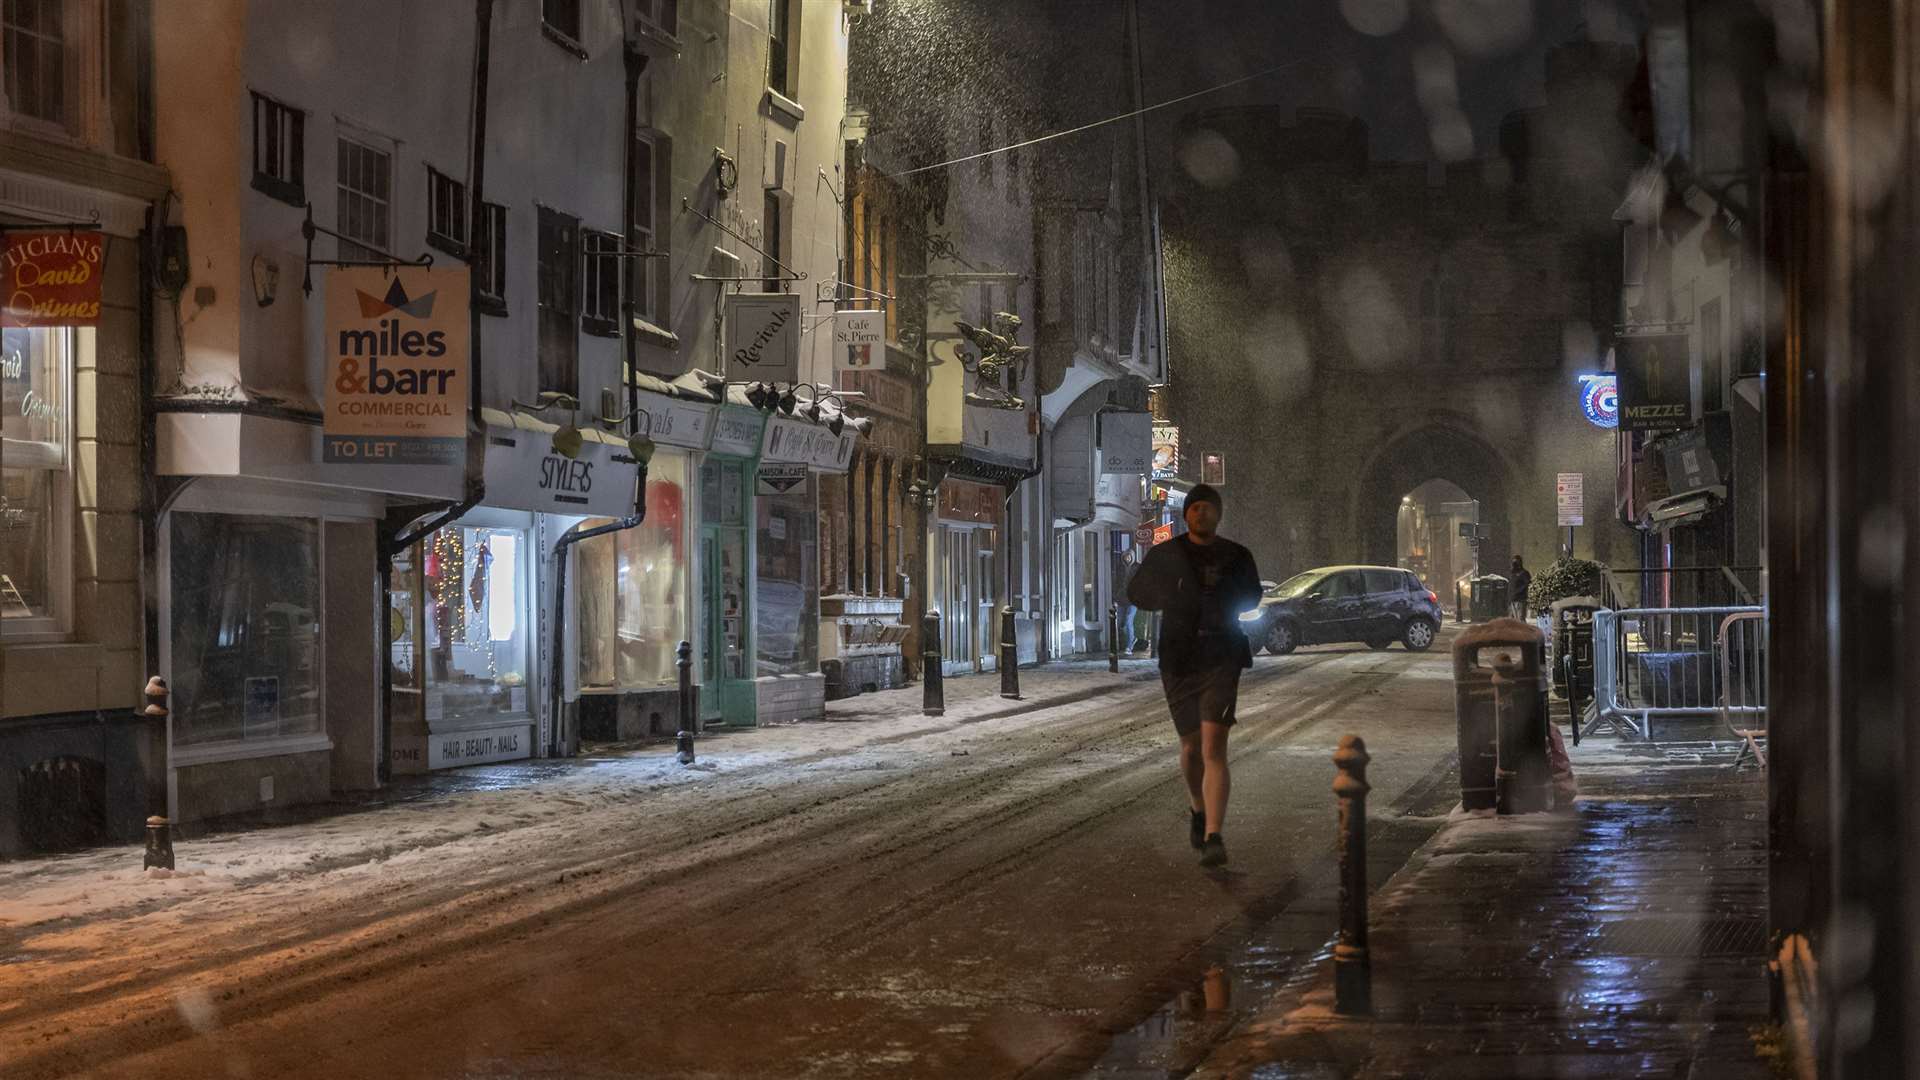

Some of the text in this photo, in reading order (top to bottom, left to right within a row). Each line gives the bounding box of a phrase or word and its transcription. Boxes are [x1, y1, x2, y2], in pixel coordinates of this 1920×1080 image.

[15, 260, 90, 289] David
[847, 319, 870, 330] Café
[340, 319, 446, 357] miles
[733, 308, 791, 367] Revivals
[852, 331, 880, 342] Pierre
[338, 402, 452, 416] COMMERCIAL
[1624, 404, 1686, 418] MEZZE
[331, 441, 358, 457] TO
[364, 441, 397, 457] LET
[539, 456, 594, 493] STYLERS
[443, 741, 460, 761] HAIR
[465, 737, 493, 757] BEAUTY
[498, 735, 518, 753] NAILS
